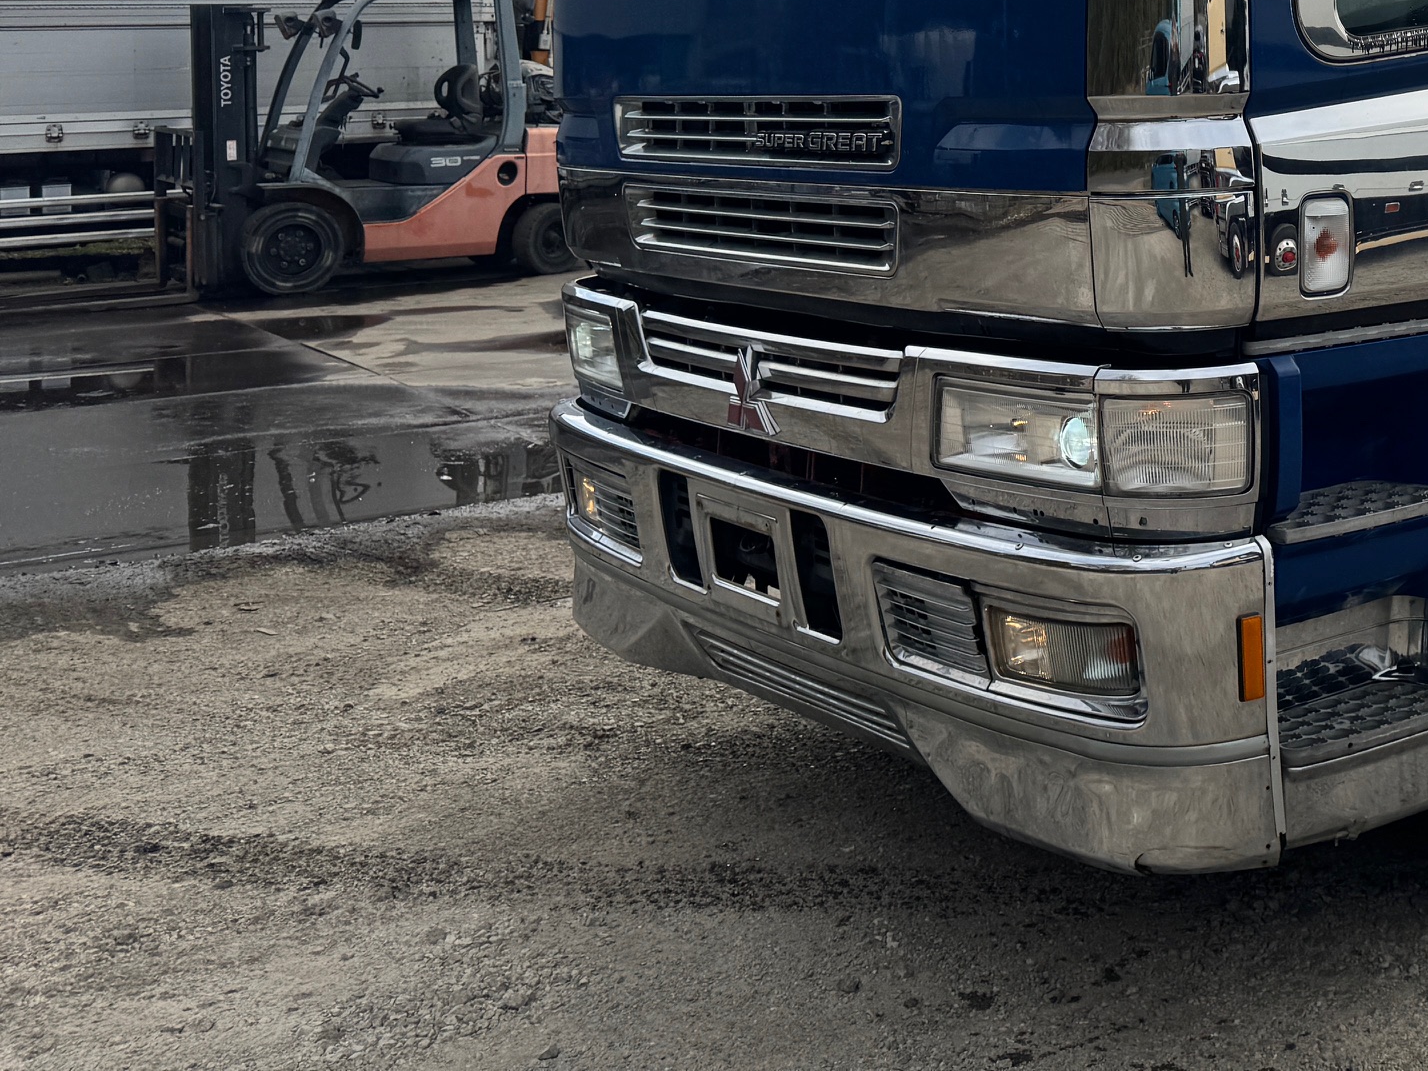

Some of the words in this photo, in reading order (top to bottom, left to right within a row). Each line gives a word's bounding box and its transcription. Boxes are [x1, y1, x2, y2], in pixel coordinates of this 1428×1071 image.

[220, 55, 232, 108] TOYOTA
[756, 133, 804, 148] SUPER
[808, 132, 882, 151] GREAT
[430, 156, 461, 168] 30
